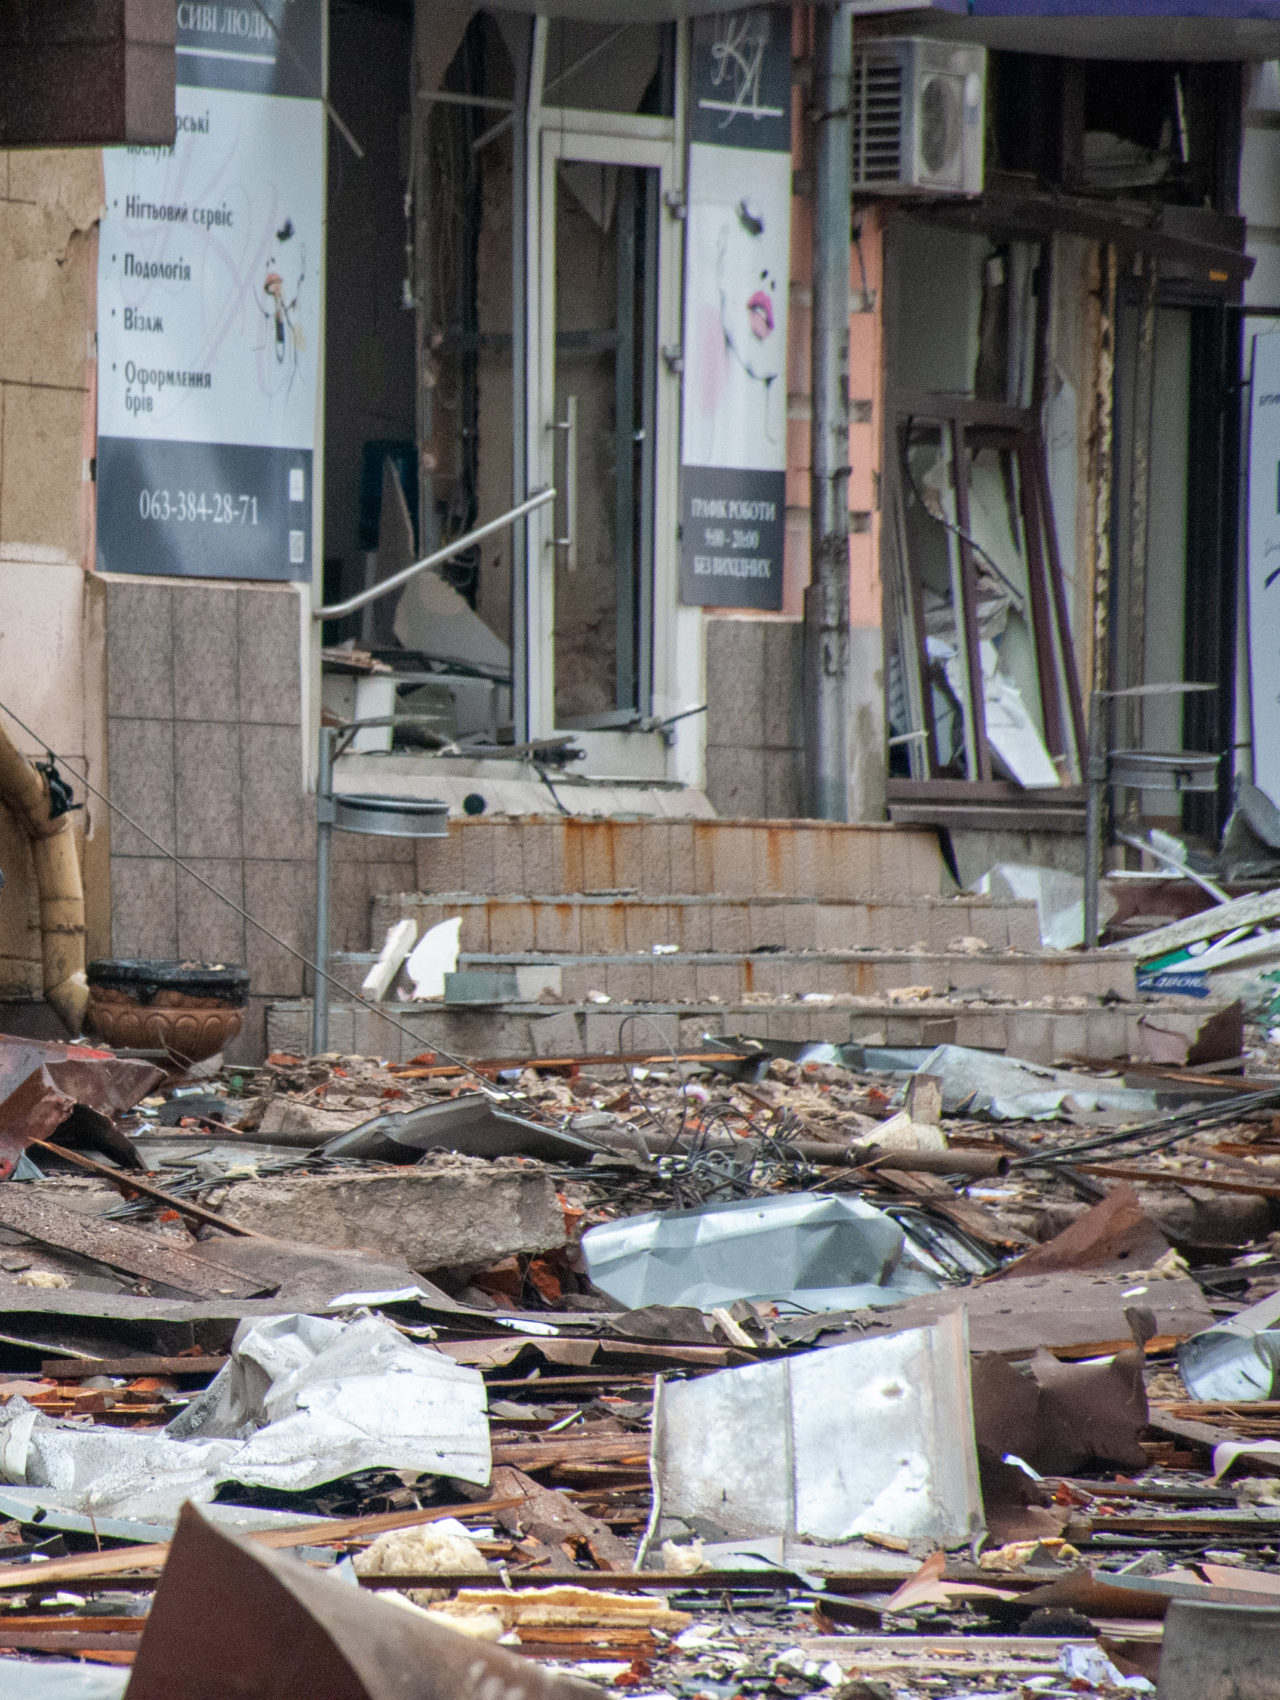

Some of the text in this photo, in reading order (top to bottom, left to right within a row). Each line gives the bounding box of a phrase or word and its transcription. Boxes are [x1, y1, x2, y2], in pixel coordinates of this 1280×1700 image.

[125, 195, 188, 223] Нігтьовий
[124, 253, 191, 282] Подологія
[123, 307, 164, 333] Візаж
[124, 360, 212, 394] Оформлення
[124, 387, 154, 416] брів
[139, 488, 259, 526] 063-384-28-71
[728, 499, 776, 522] РОБОТИ
